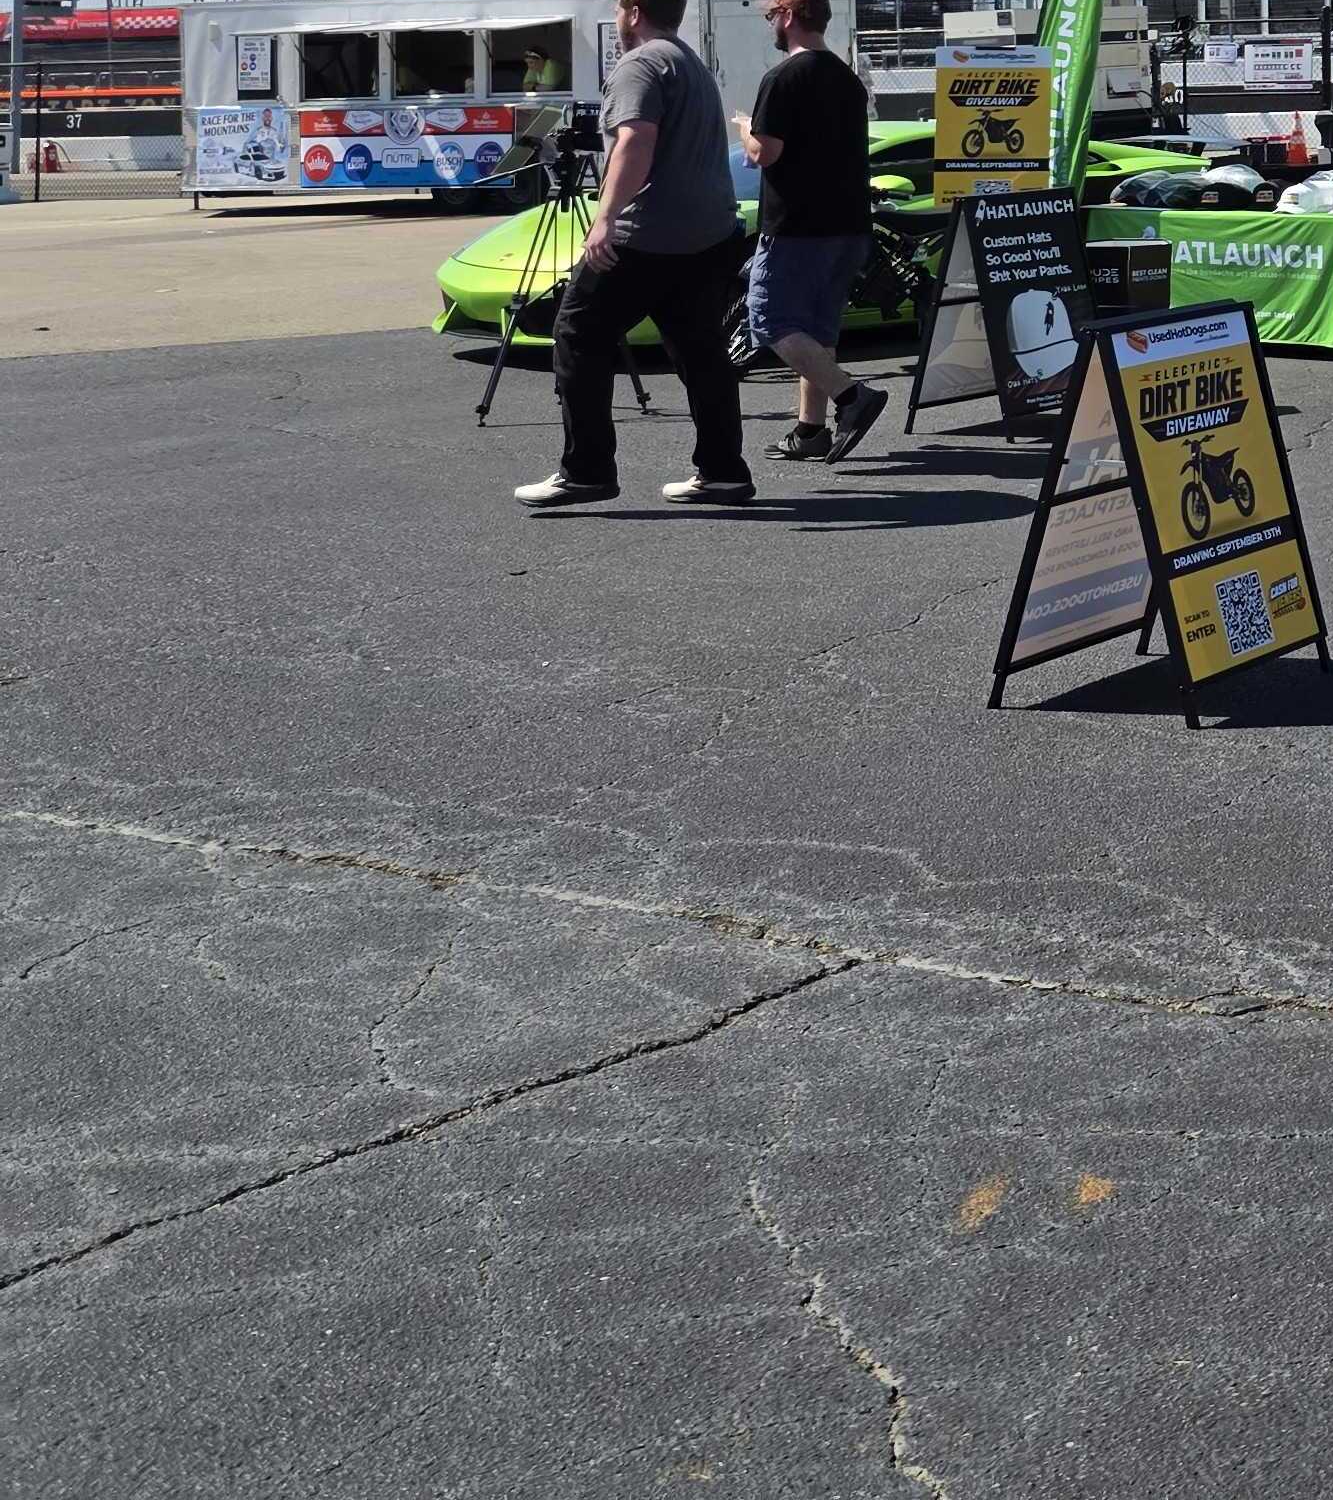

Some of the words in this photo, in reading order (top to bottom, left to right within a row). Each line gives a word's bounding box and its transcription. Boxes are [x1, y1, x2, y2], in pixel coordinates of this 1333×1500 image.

[949, 79, 995, 95] DIRT
[995, 79, 1040, 95] BIKE
[965, 97, 1022, 106] GIVEAWAY
[66, 114, 82, 129] 37
[201, 115, 222, 126] RACE
[223, 114, 239, 124] FOR
[241, 112, 256, 122] THE
[204, 124, 250, 137] MOUNTAINS
[985, 198, 1075, 220] HATLAUNCH
[983, 233, 1025, 248] Custom
[1027, 231, 1052, 244] Hats
[986, 253, 1000, 266] So
[1002, 249, 1032, 263] Good
[1172, 240, 1324, 270] ATLAUNCH
[1012, 268, 1038, 281] Your
[1039, 264, 1073, 277] Pants.
[1090, 268, 1119, 277] UDE
[1148, 320, 1228, 344] UsedHotDogs.com
[1155, 358, 1221, 381] ELECTRIC
[1139, 378, 1191, 420] DIRT
[1195, 367, 1243, 407] BIKE
[1166, 407, 1230, 436] GIVEAWAY
[1173, 547, 1216, 570] DRAWING
[1216, 532, 1264, 555] SEPTEMBER
[1184, 613, 1200, 625] SCAN
[1186, 623, 1217, 643] ENTER
